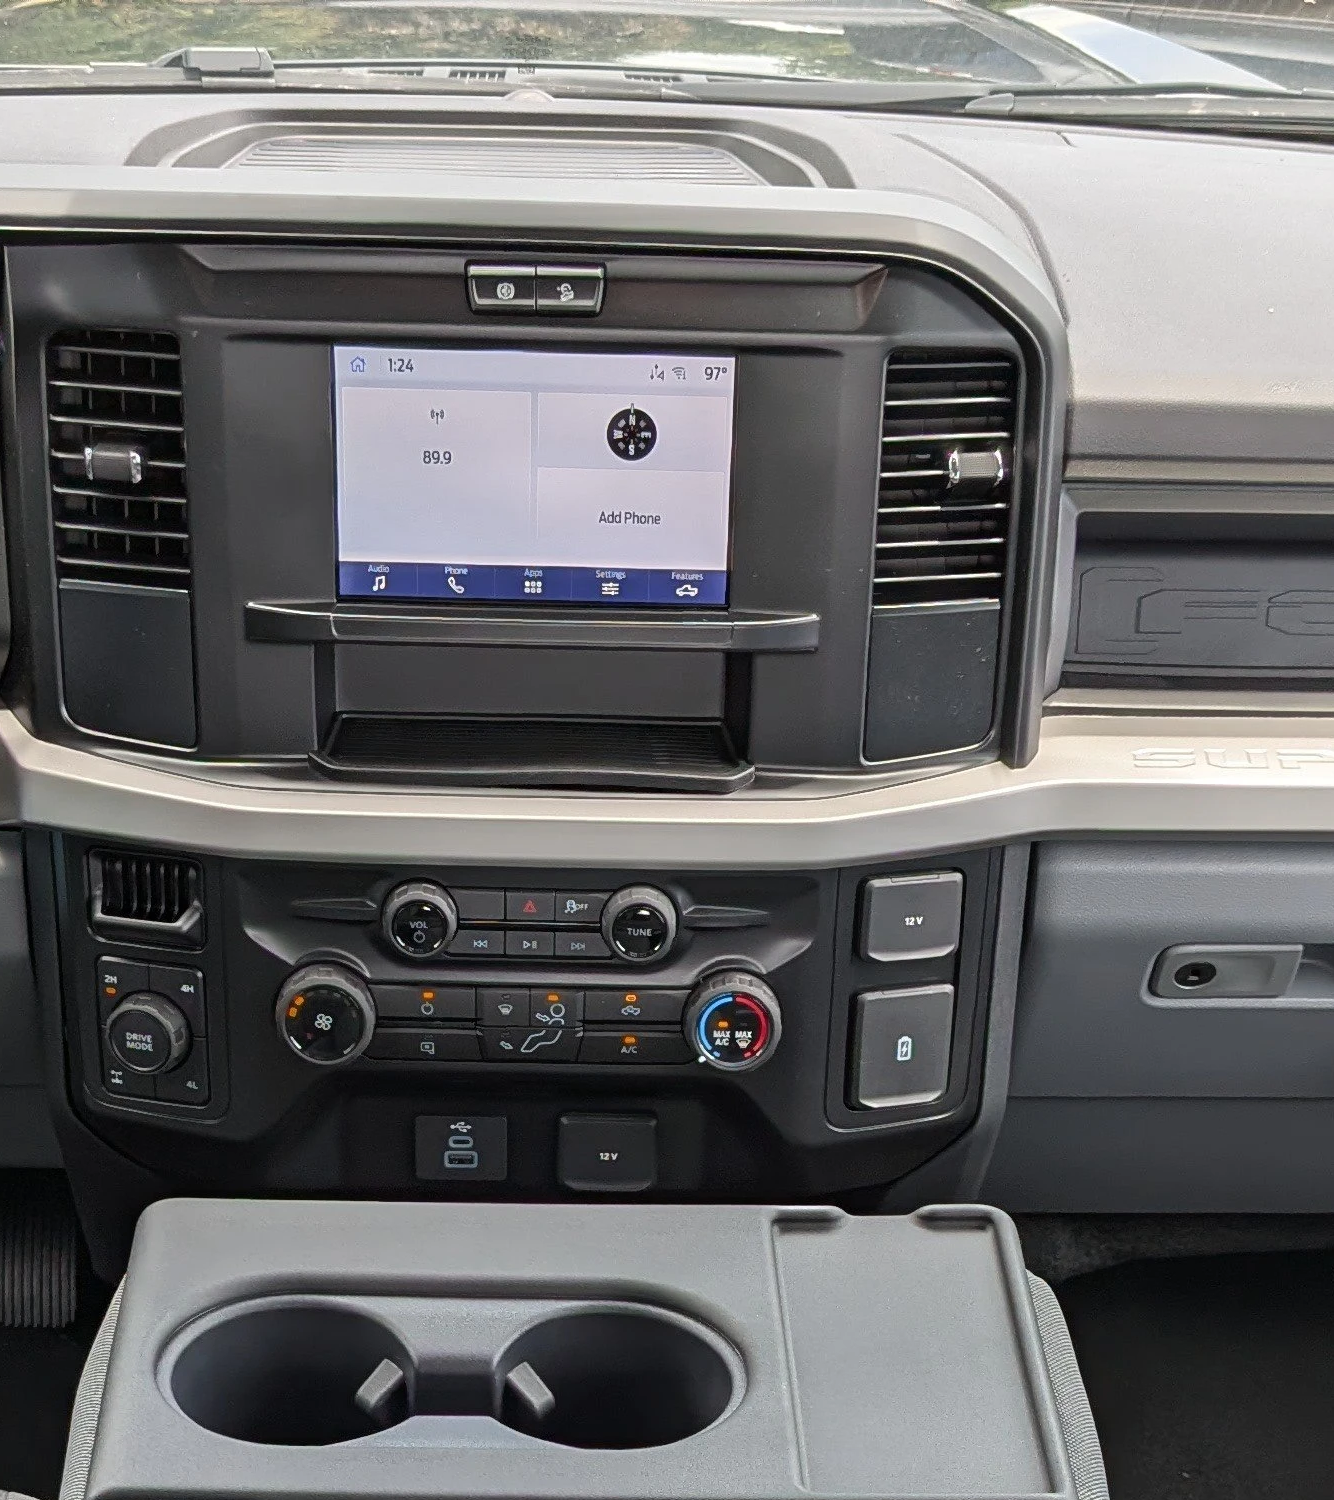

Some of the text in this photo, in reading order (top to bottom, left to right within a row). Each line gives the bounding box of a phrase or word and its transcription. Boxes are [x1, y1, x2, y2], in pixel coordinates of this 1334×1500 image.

[387, 357, 414, 374] 1:24
[422, 449, 452, 465] 89.9
[599, 511, 661, 525] Add Phone
[367, 564, 389, 573] Audio
[444, 566, 468, 575] Phone
[524, 568, 543, 579] Apps
[595, 569, 626, 580] Settings
[671, 571, 704, 581] Features
[575, 902, 589, 911] OFF
[409, 920, 429, 930] VOL
[904, 916, 924, 926] 12 V
[627, 927, 653, 938] TUNE
[104, 974, 118, 984] 2H
[126, 1031, 152, 1043] DRIVE
[713, 1030, 731, 1039] MAX
[734, 1030, 752, 1039] MAX
[126, 1041, 153, 1052] MODE
[714, 1038, 730, 1046] A/C
[620, 1046, 638, 1054] A/C
[186, 1081, 198, 1090] 4L
[599, 1152, 619, 1161] 12 V
